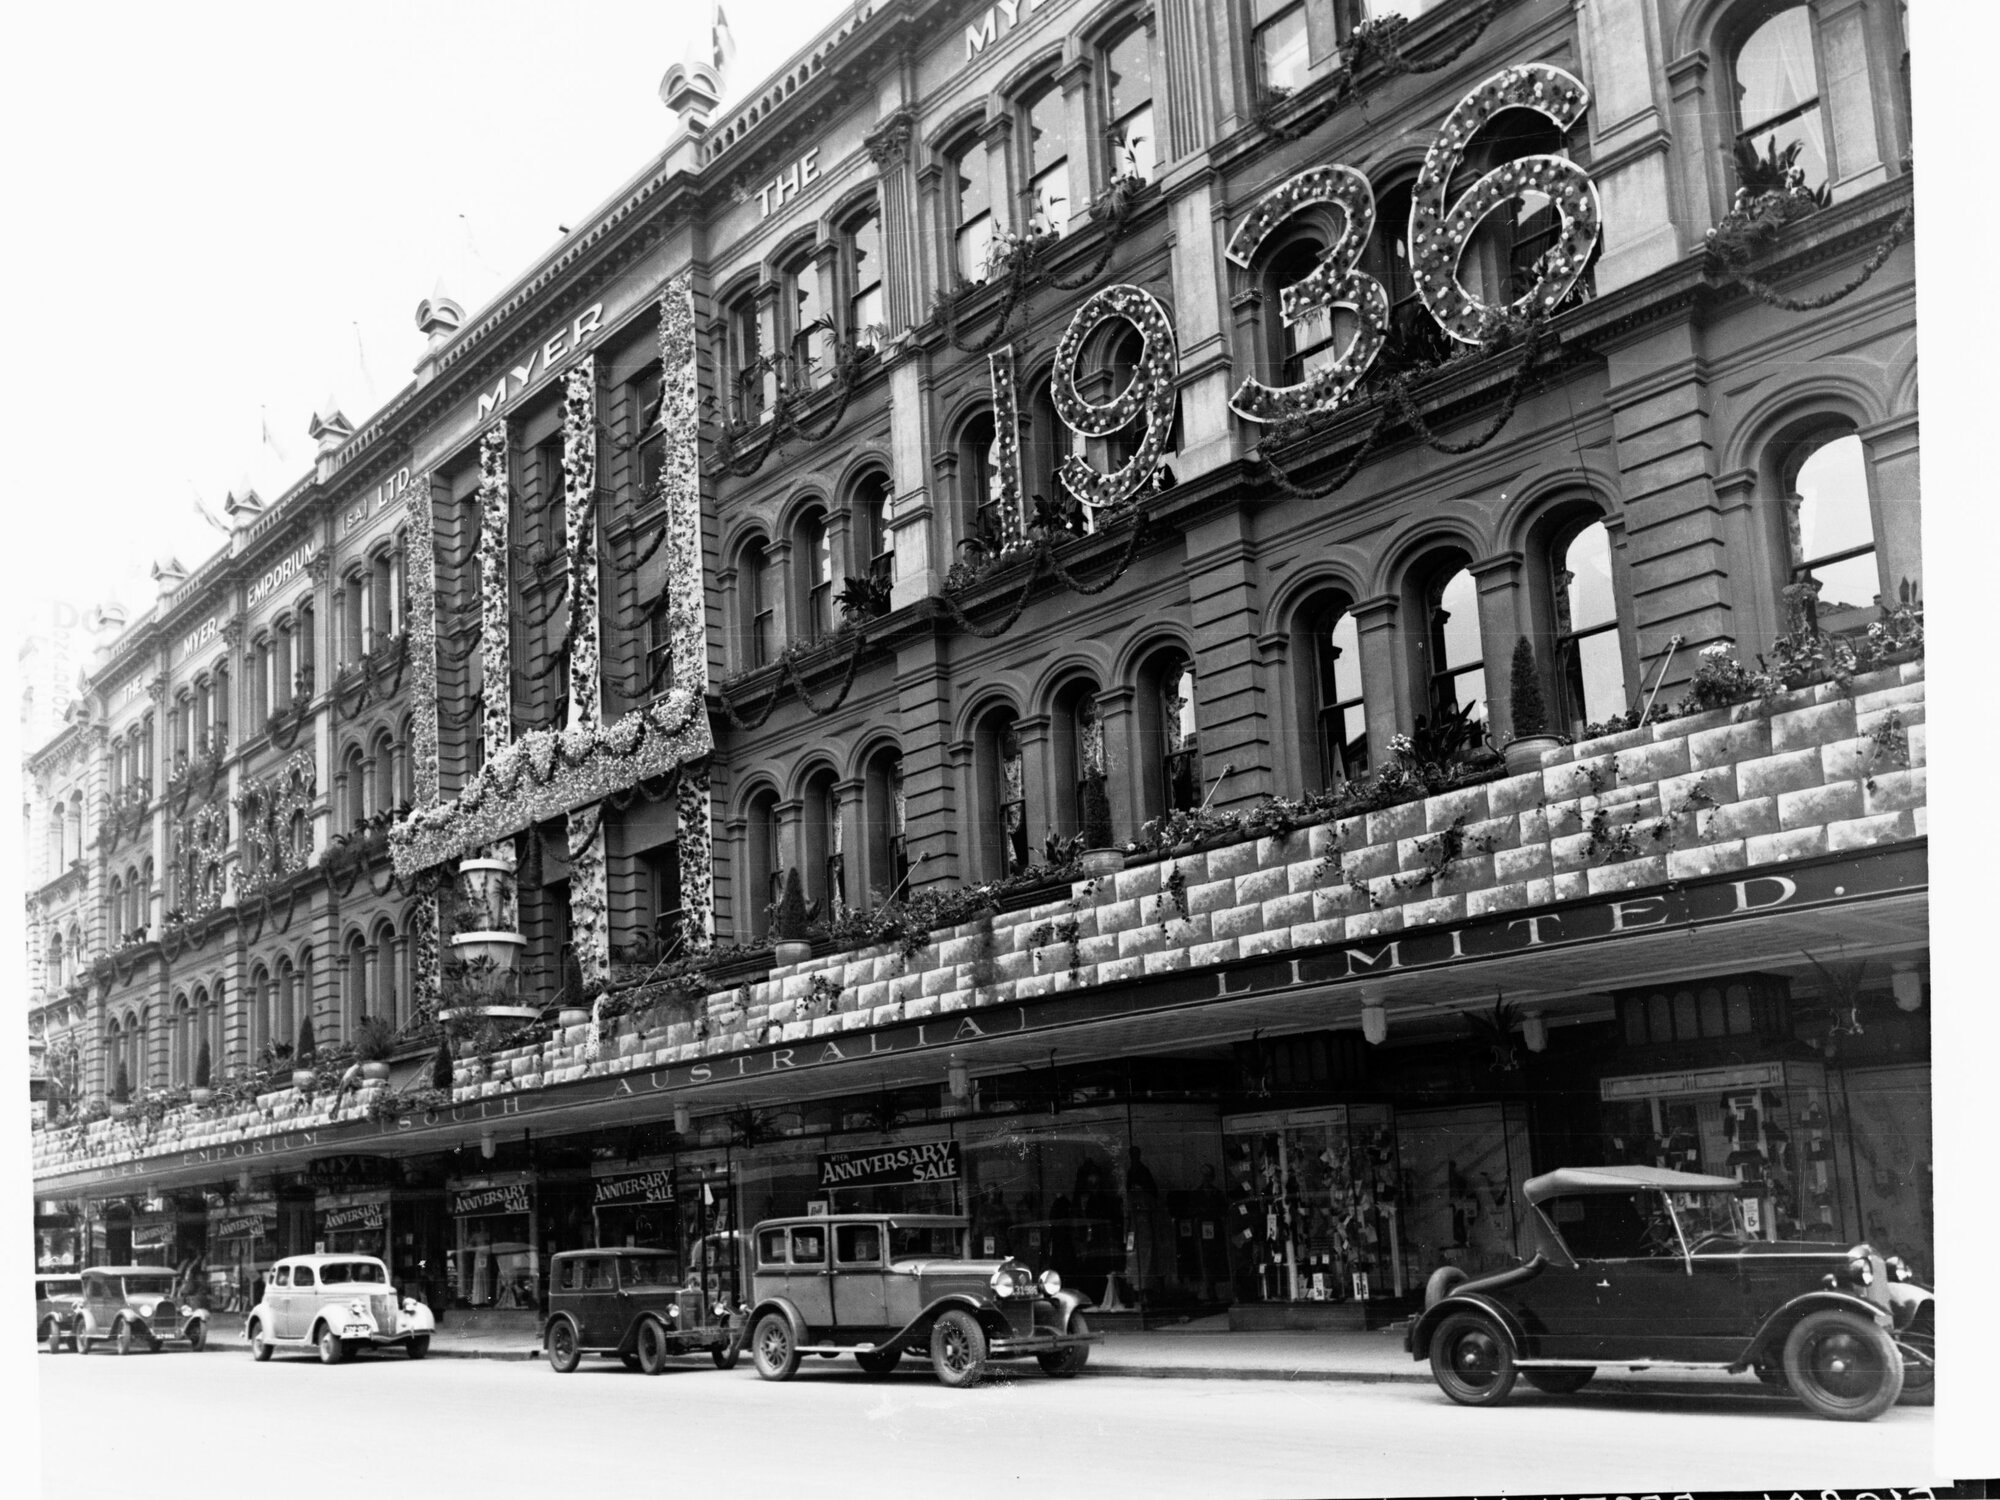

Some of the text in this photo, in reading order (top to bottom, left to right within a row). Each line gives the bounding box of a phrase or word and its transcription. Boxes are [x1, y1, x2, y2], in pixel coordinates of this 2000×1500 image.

[755, 0, 1042, 219] THE MY
[988, 63, 1601, 547] 1936
[477, 302, 604, 421] MYER
[123, 674, 143, 701] THE
[183, 617, 217, 657] MYER
[247, 542, 315, 607] EMPORIUM
[183, 1132, 318, 1166] EMPORIUM
[822, 1140, 951, 1184] ANNIVERSARY
[594, 1169, 671, 1202] ANNIVERSARY
[913, 1158, 956, 1182] SALE
[455, 1184, 526, 1213] ANNIVERSARY
[504, 1196, 529, 1213] SALE
[646, 1184, 673, 1202] SALE
[325, 1203, 381, 1228] ANNIVERSARY
[364, 1214, 383, 1228] SALE
